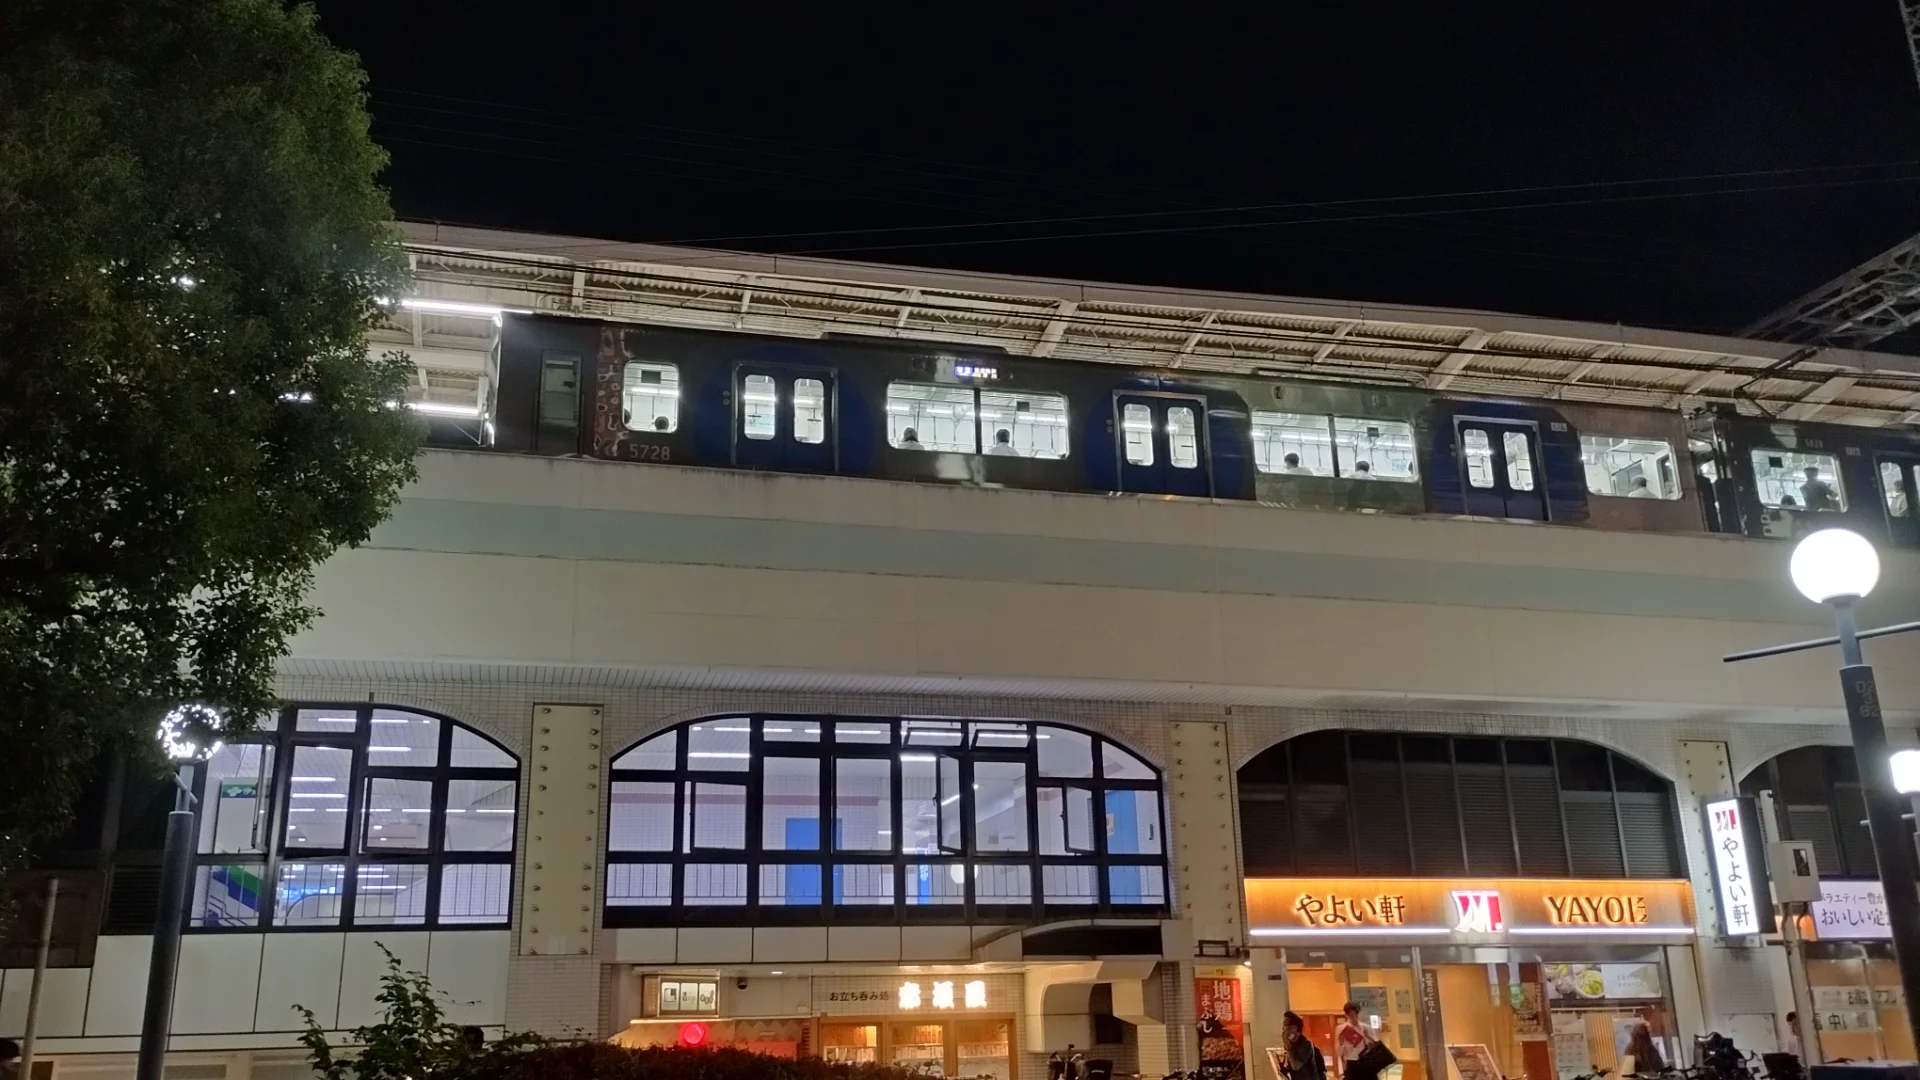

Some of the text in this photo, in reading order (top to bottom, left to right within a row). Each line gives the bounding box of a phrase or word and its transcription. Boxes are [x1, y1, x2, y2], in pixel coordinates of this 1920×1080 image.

[630, 444, 670, 460] 5728
[1722, 837, 1750, 926] やよい軒
[1295, 894, 1405, 925] やよい軒
[1547, 896, 1635, 923] YAYOI
[1821, 908, 1891, 926] おいしい定
[829, 990, 890, 1002] お立ち呑み処
[1213, 980, 1232, 1021] 地鶏
